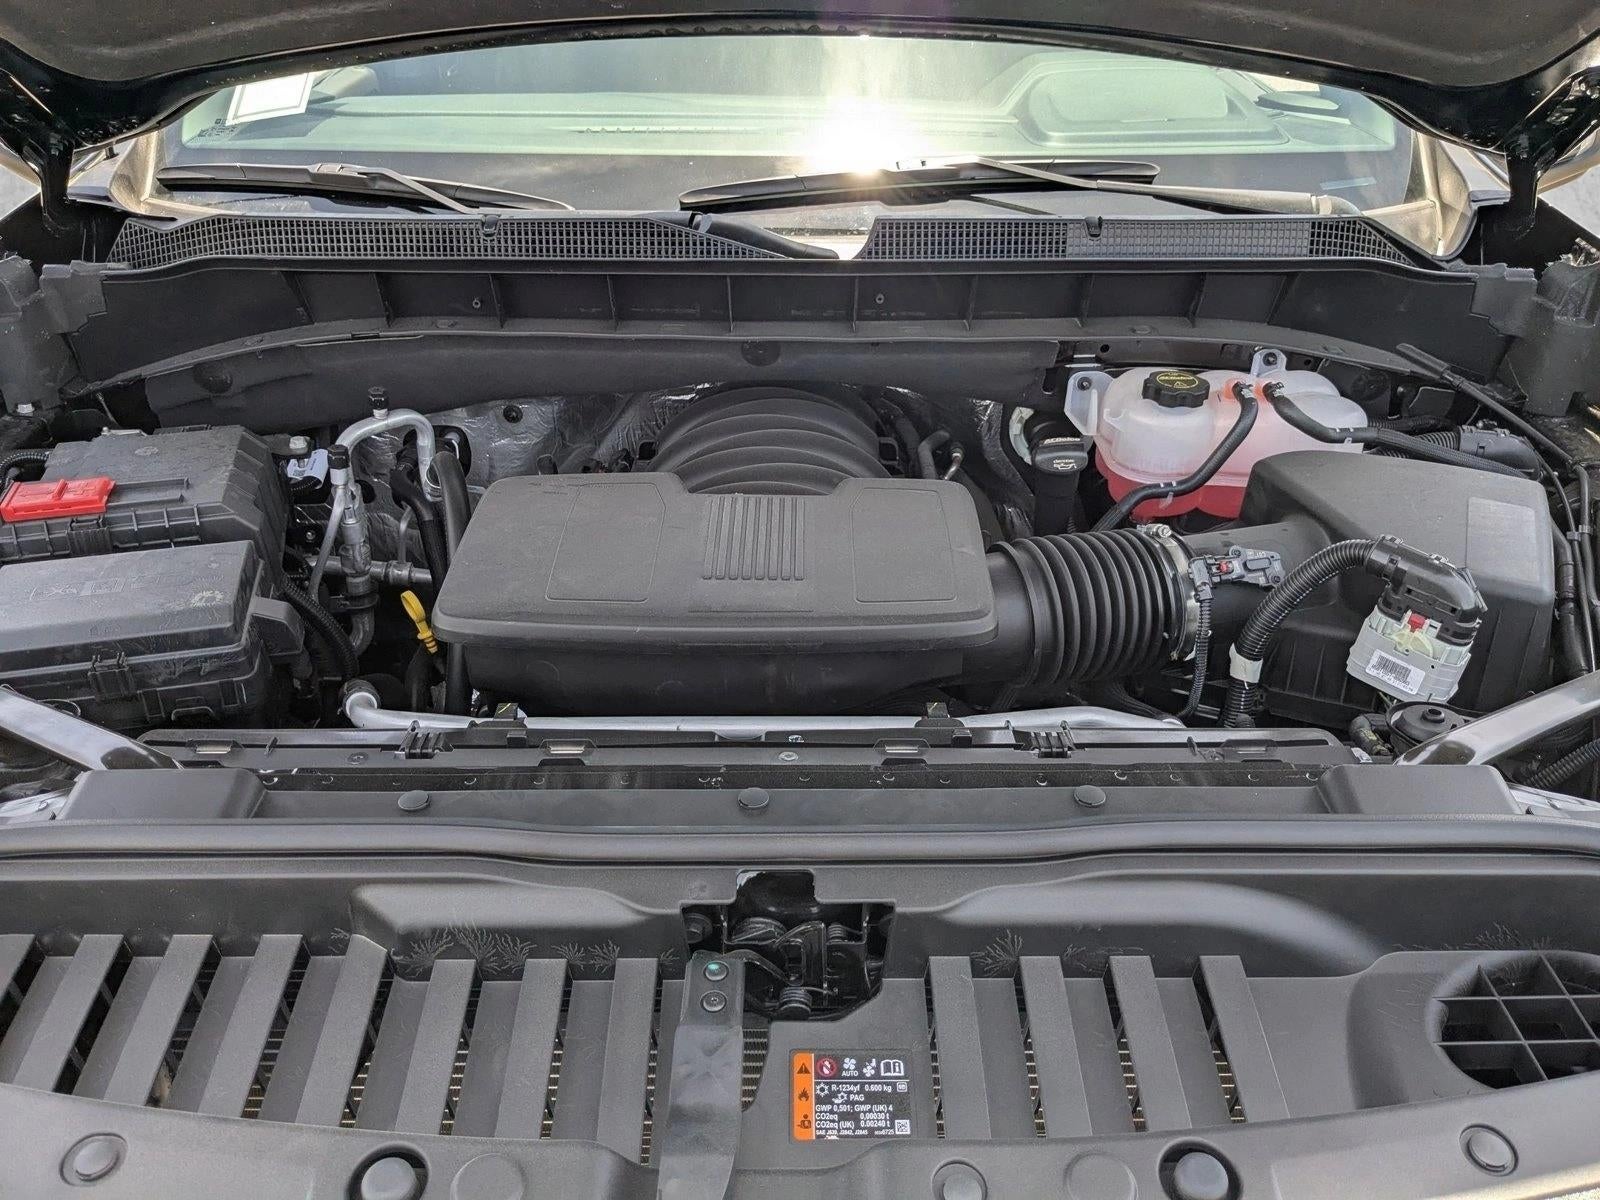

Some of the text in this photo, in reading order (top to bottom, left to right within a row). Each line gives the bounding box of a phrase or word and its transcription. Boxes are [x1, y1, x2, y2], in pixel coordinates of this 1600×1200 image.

[831, 1084, 861, 1093] R-1234yf
[864, 1084, 883, 1092] 0.600
[883, 1084, 892, 1093] kg
[815, 1104, 832, 1112] GWP
[854, 1104, 871, 1112] GWP
[872, 1104, 888, 1113] (UK)
[888, 1104, 894, 1112] 4
[815, 1112, 839, 1121] CO2eq
[860, 1112, 886, 1120] 0,00030
[815, 1120, 839, 1129] CO2eq
[839, 1120, 855, 1129] (UK)
[860, 1120, 886, 1128] 0.00240
